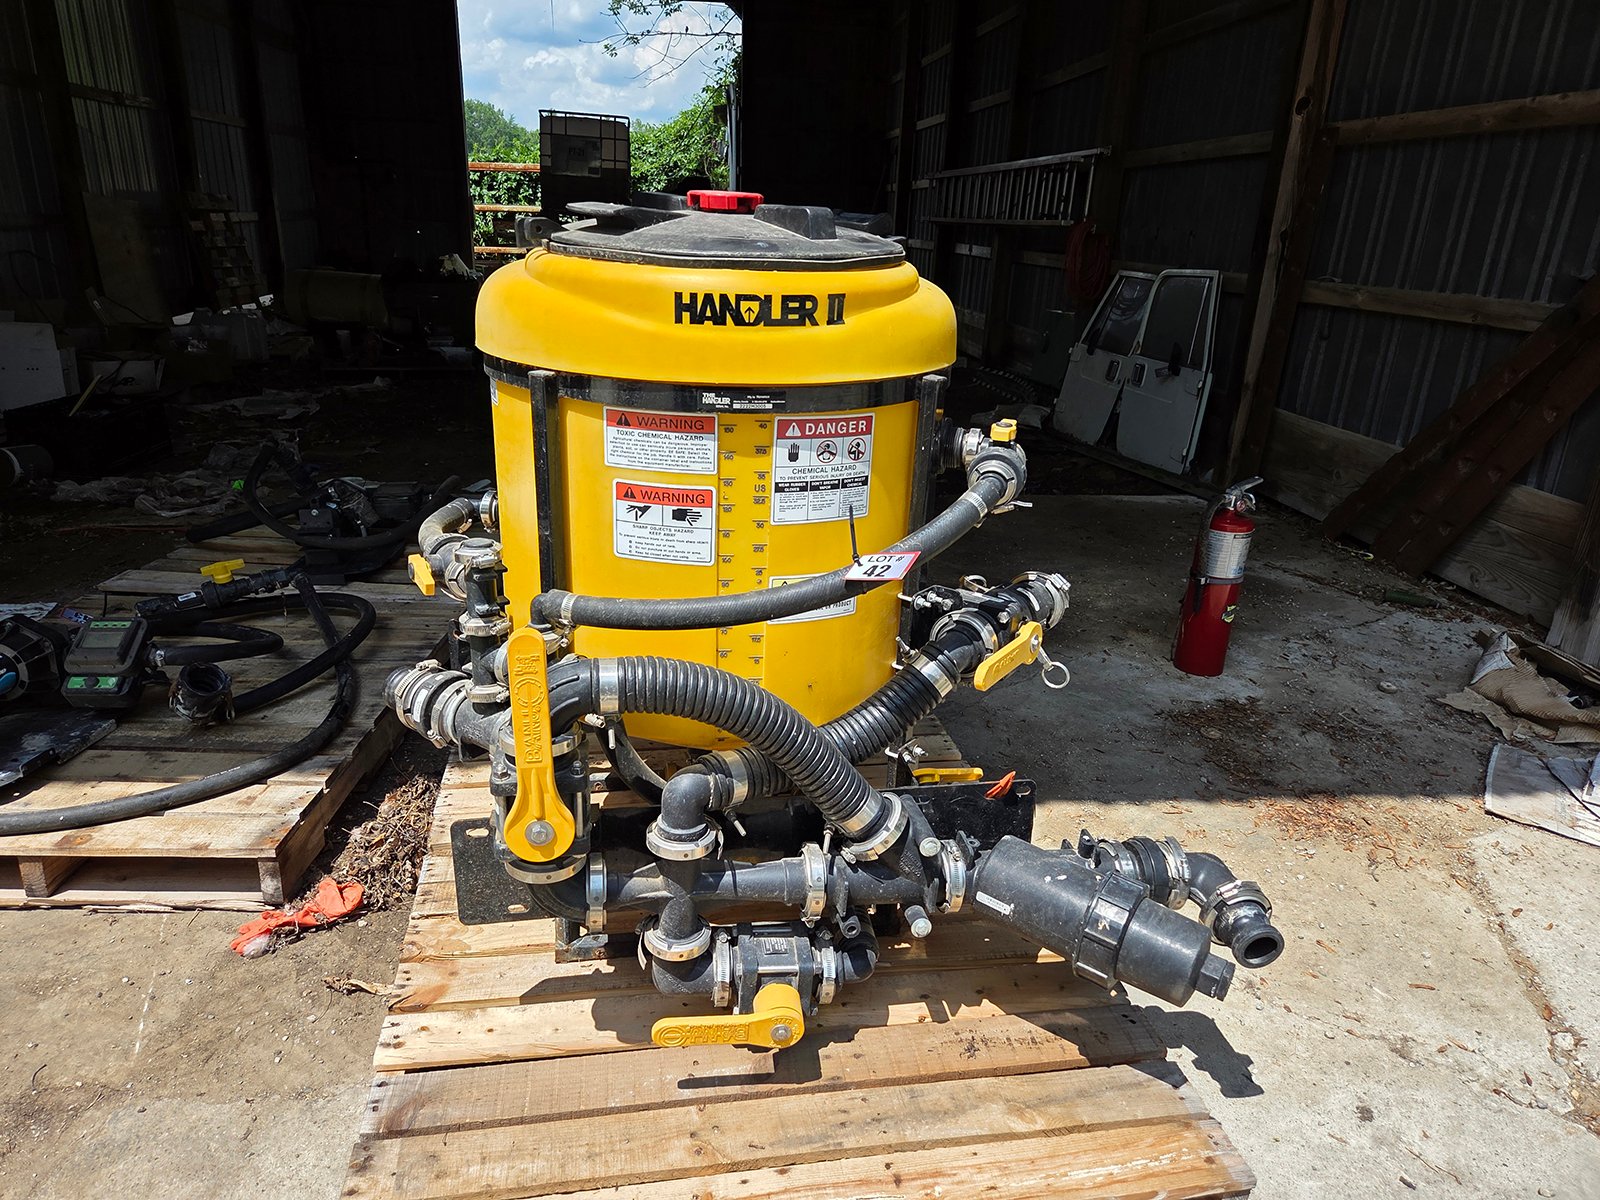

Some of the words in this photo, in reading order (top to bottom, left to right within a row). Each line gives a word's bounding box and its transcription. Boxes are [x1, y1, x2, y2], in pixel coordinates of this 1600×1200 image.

[674, 291, 820, 327] HANDLER
[826, 293, 846, 326] II
[702, 396, 731, 404] HANDLER
[636, 415, 704, 430] WARNING
[805, 420, 867, 435] DANGER
[616, 429, 635, 437] TOXIC
[637, 432, 672, 440] CHEMICAL
[792, 466, 828, 475] CHEMICAL
[831, 464, 857, 473] HAZARD
[754, 484, 766, 493] US
[640, 489, 705, 504] WARNING
[867, 555, 895, 563] LOT
[862, 564, 892, 577] 42
